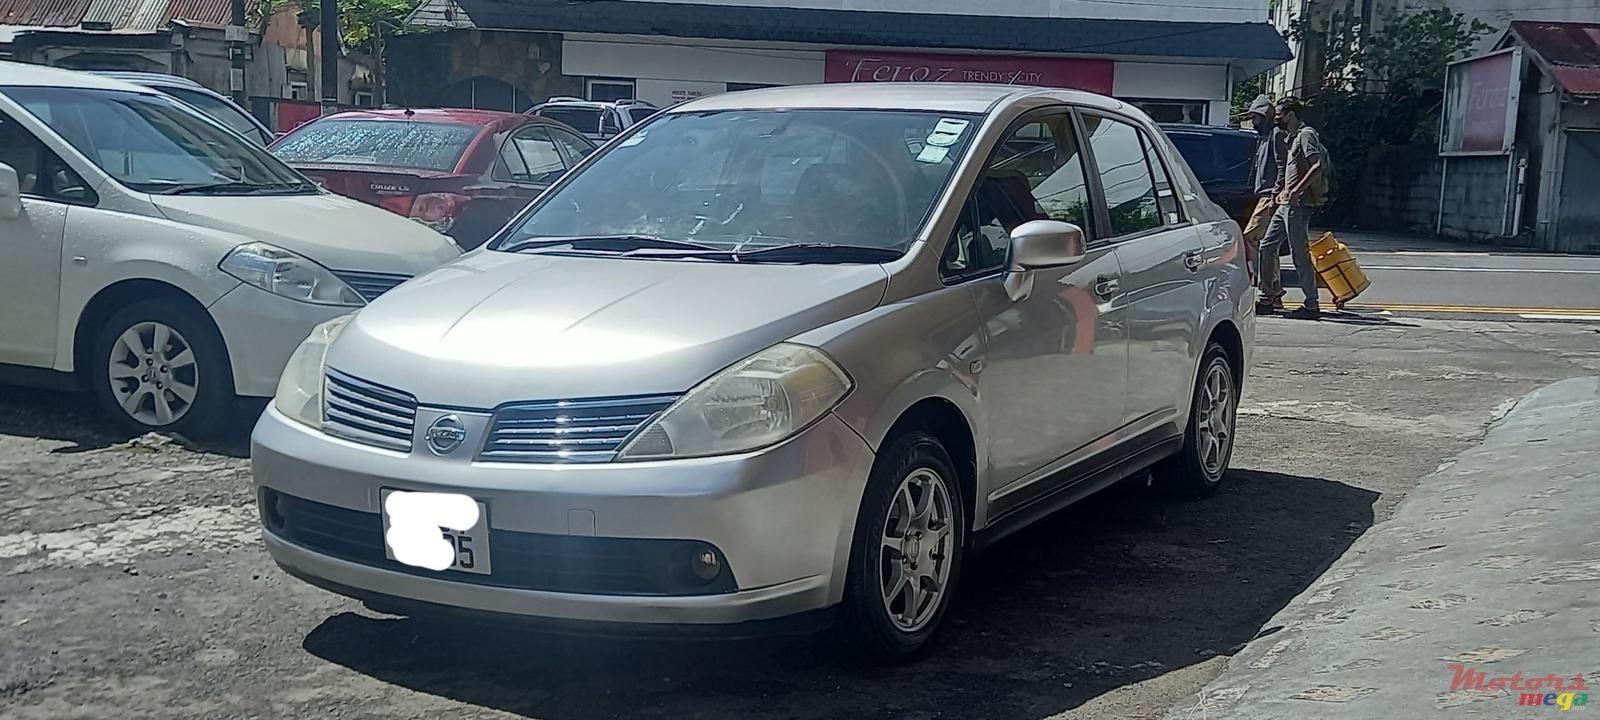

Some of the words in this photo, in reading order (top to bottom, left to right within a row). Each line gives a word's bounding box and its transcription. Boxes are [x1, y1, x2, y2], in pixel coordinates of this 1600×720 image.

[846, 58, 954, 83] Feroz
[1017, 72, 1042, 83] CITY
[370, 183, 396, 191] CRUZE
